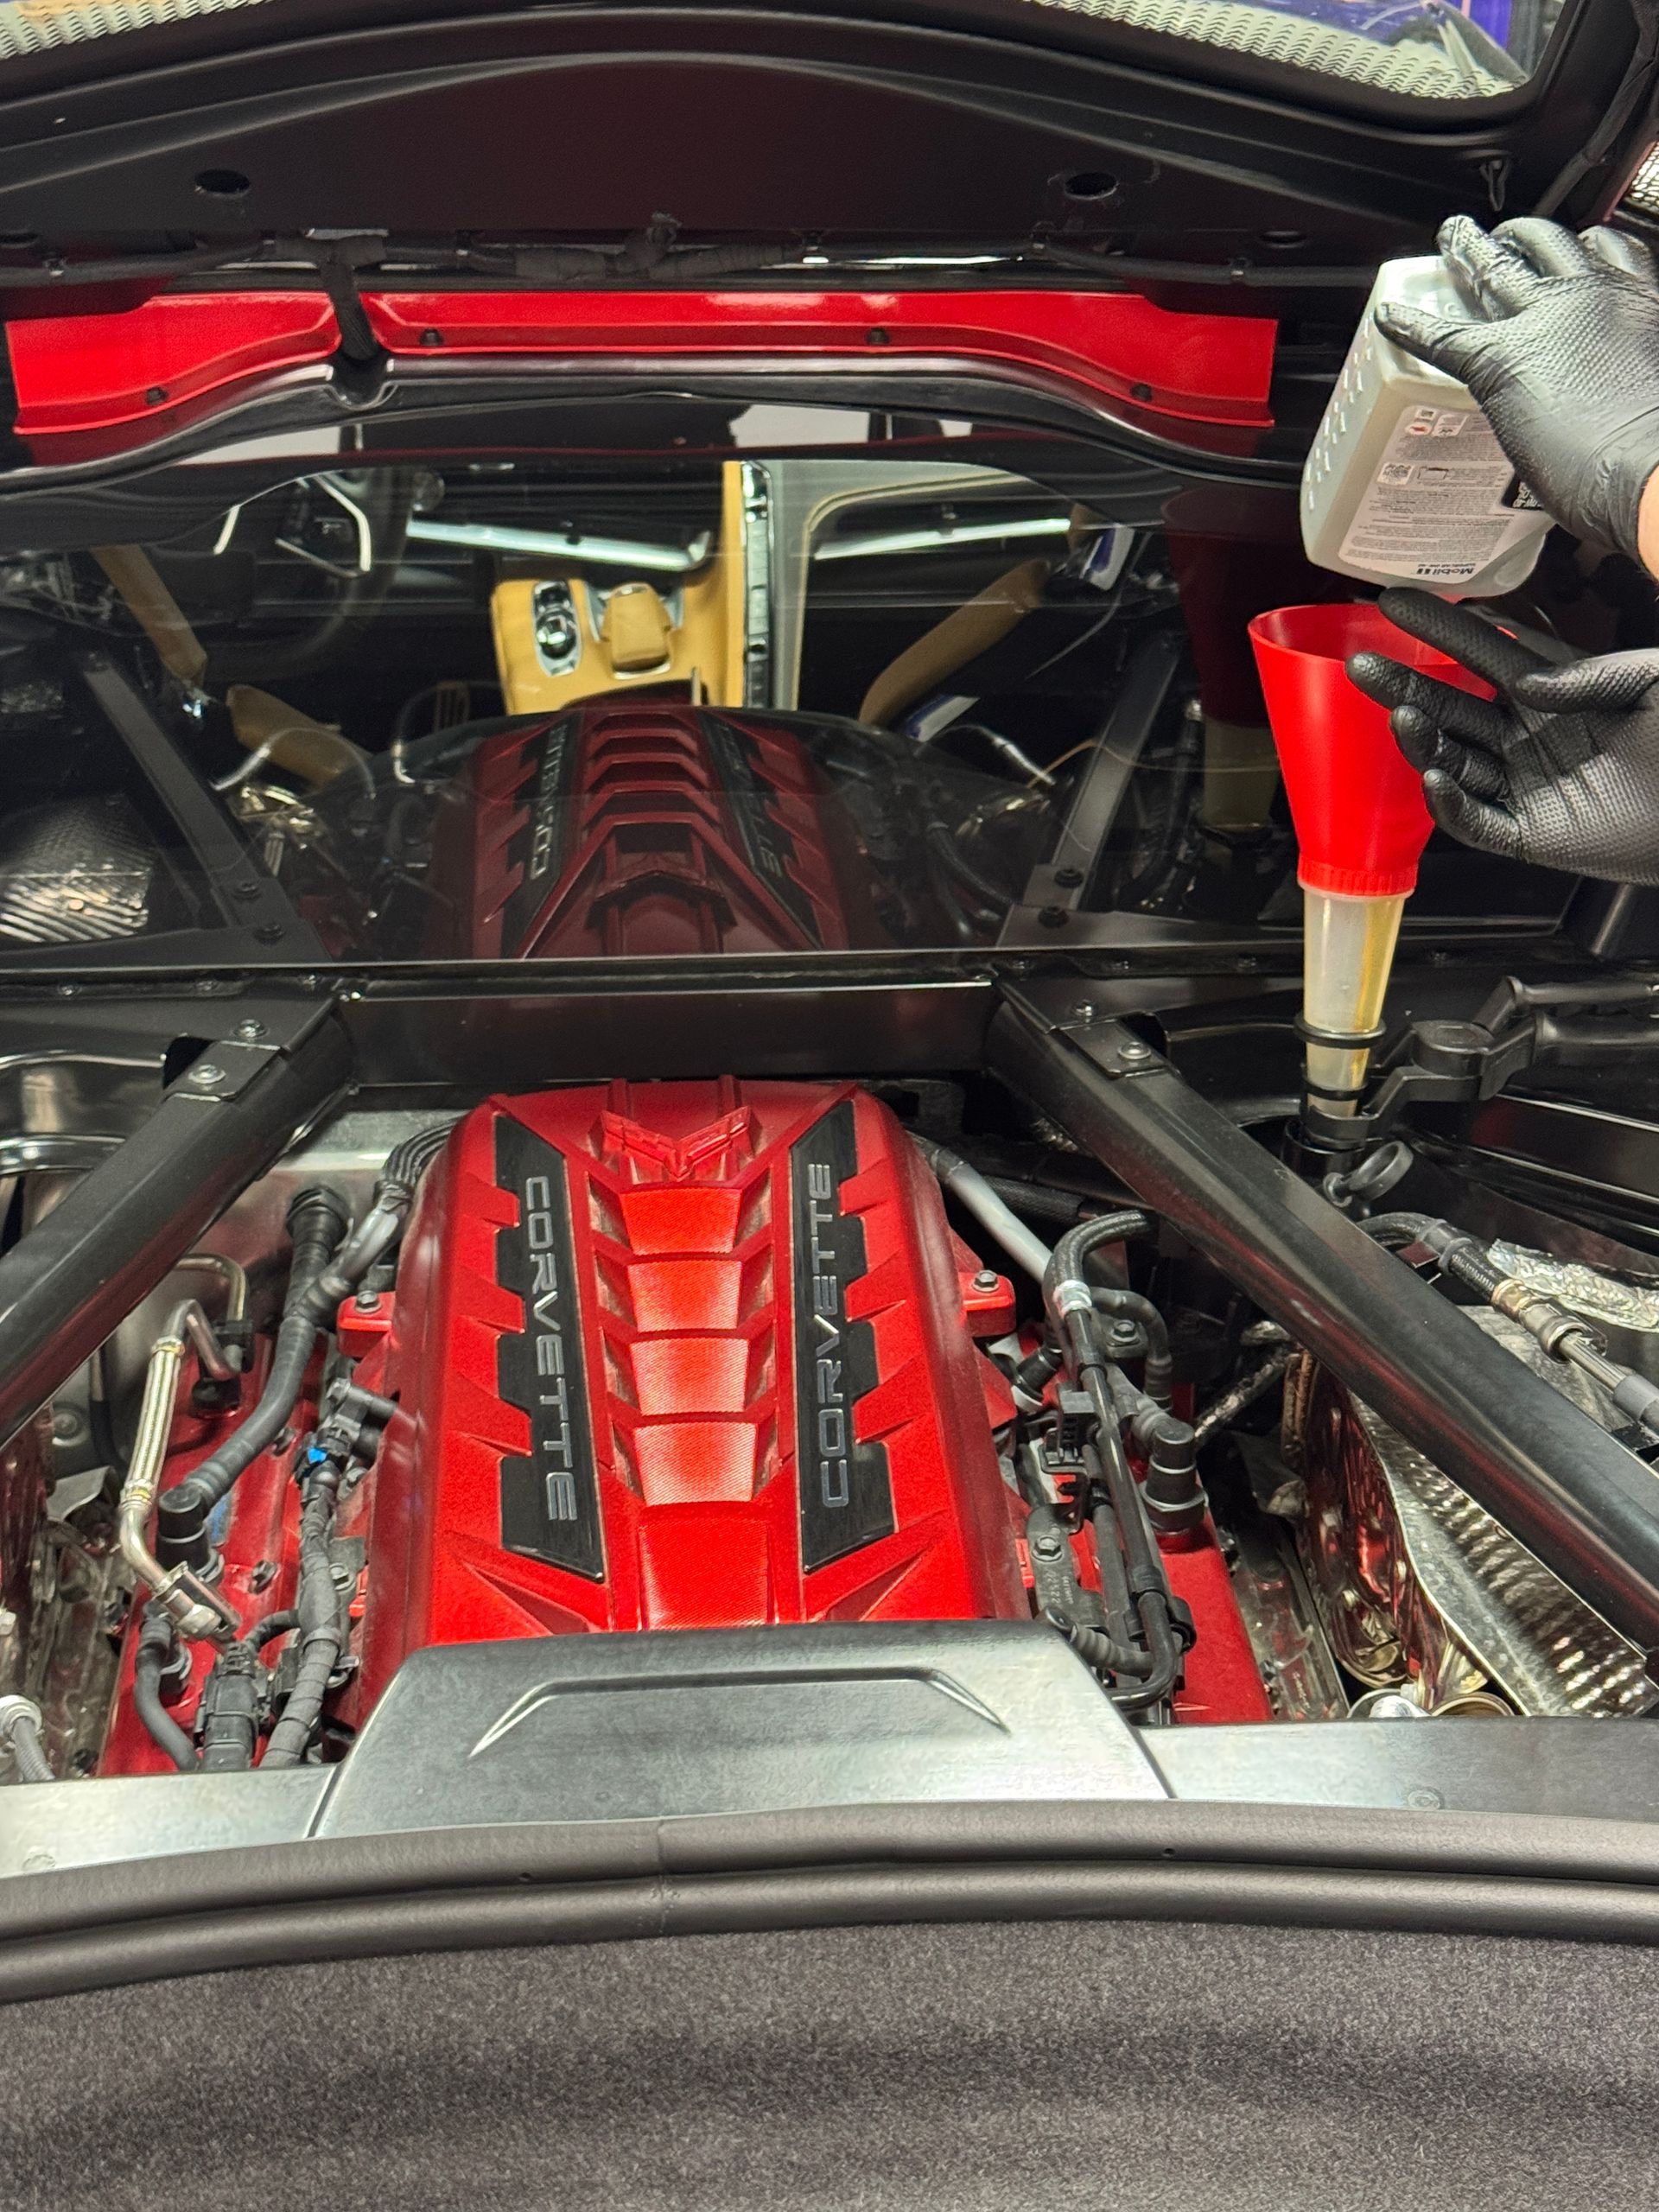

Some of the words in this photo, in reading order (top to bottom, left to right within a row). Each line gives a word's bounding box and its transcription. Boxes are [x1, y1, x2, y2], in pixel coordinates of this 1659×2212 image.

[1431, 567, 1474, 575] Mobil
[524, 1174, 578, 1522] CORVETTE
[806, 1161, 849, 1510] CORVETTE
